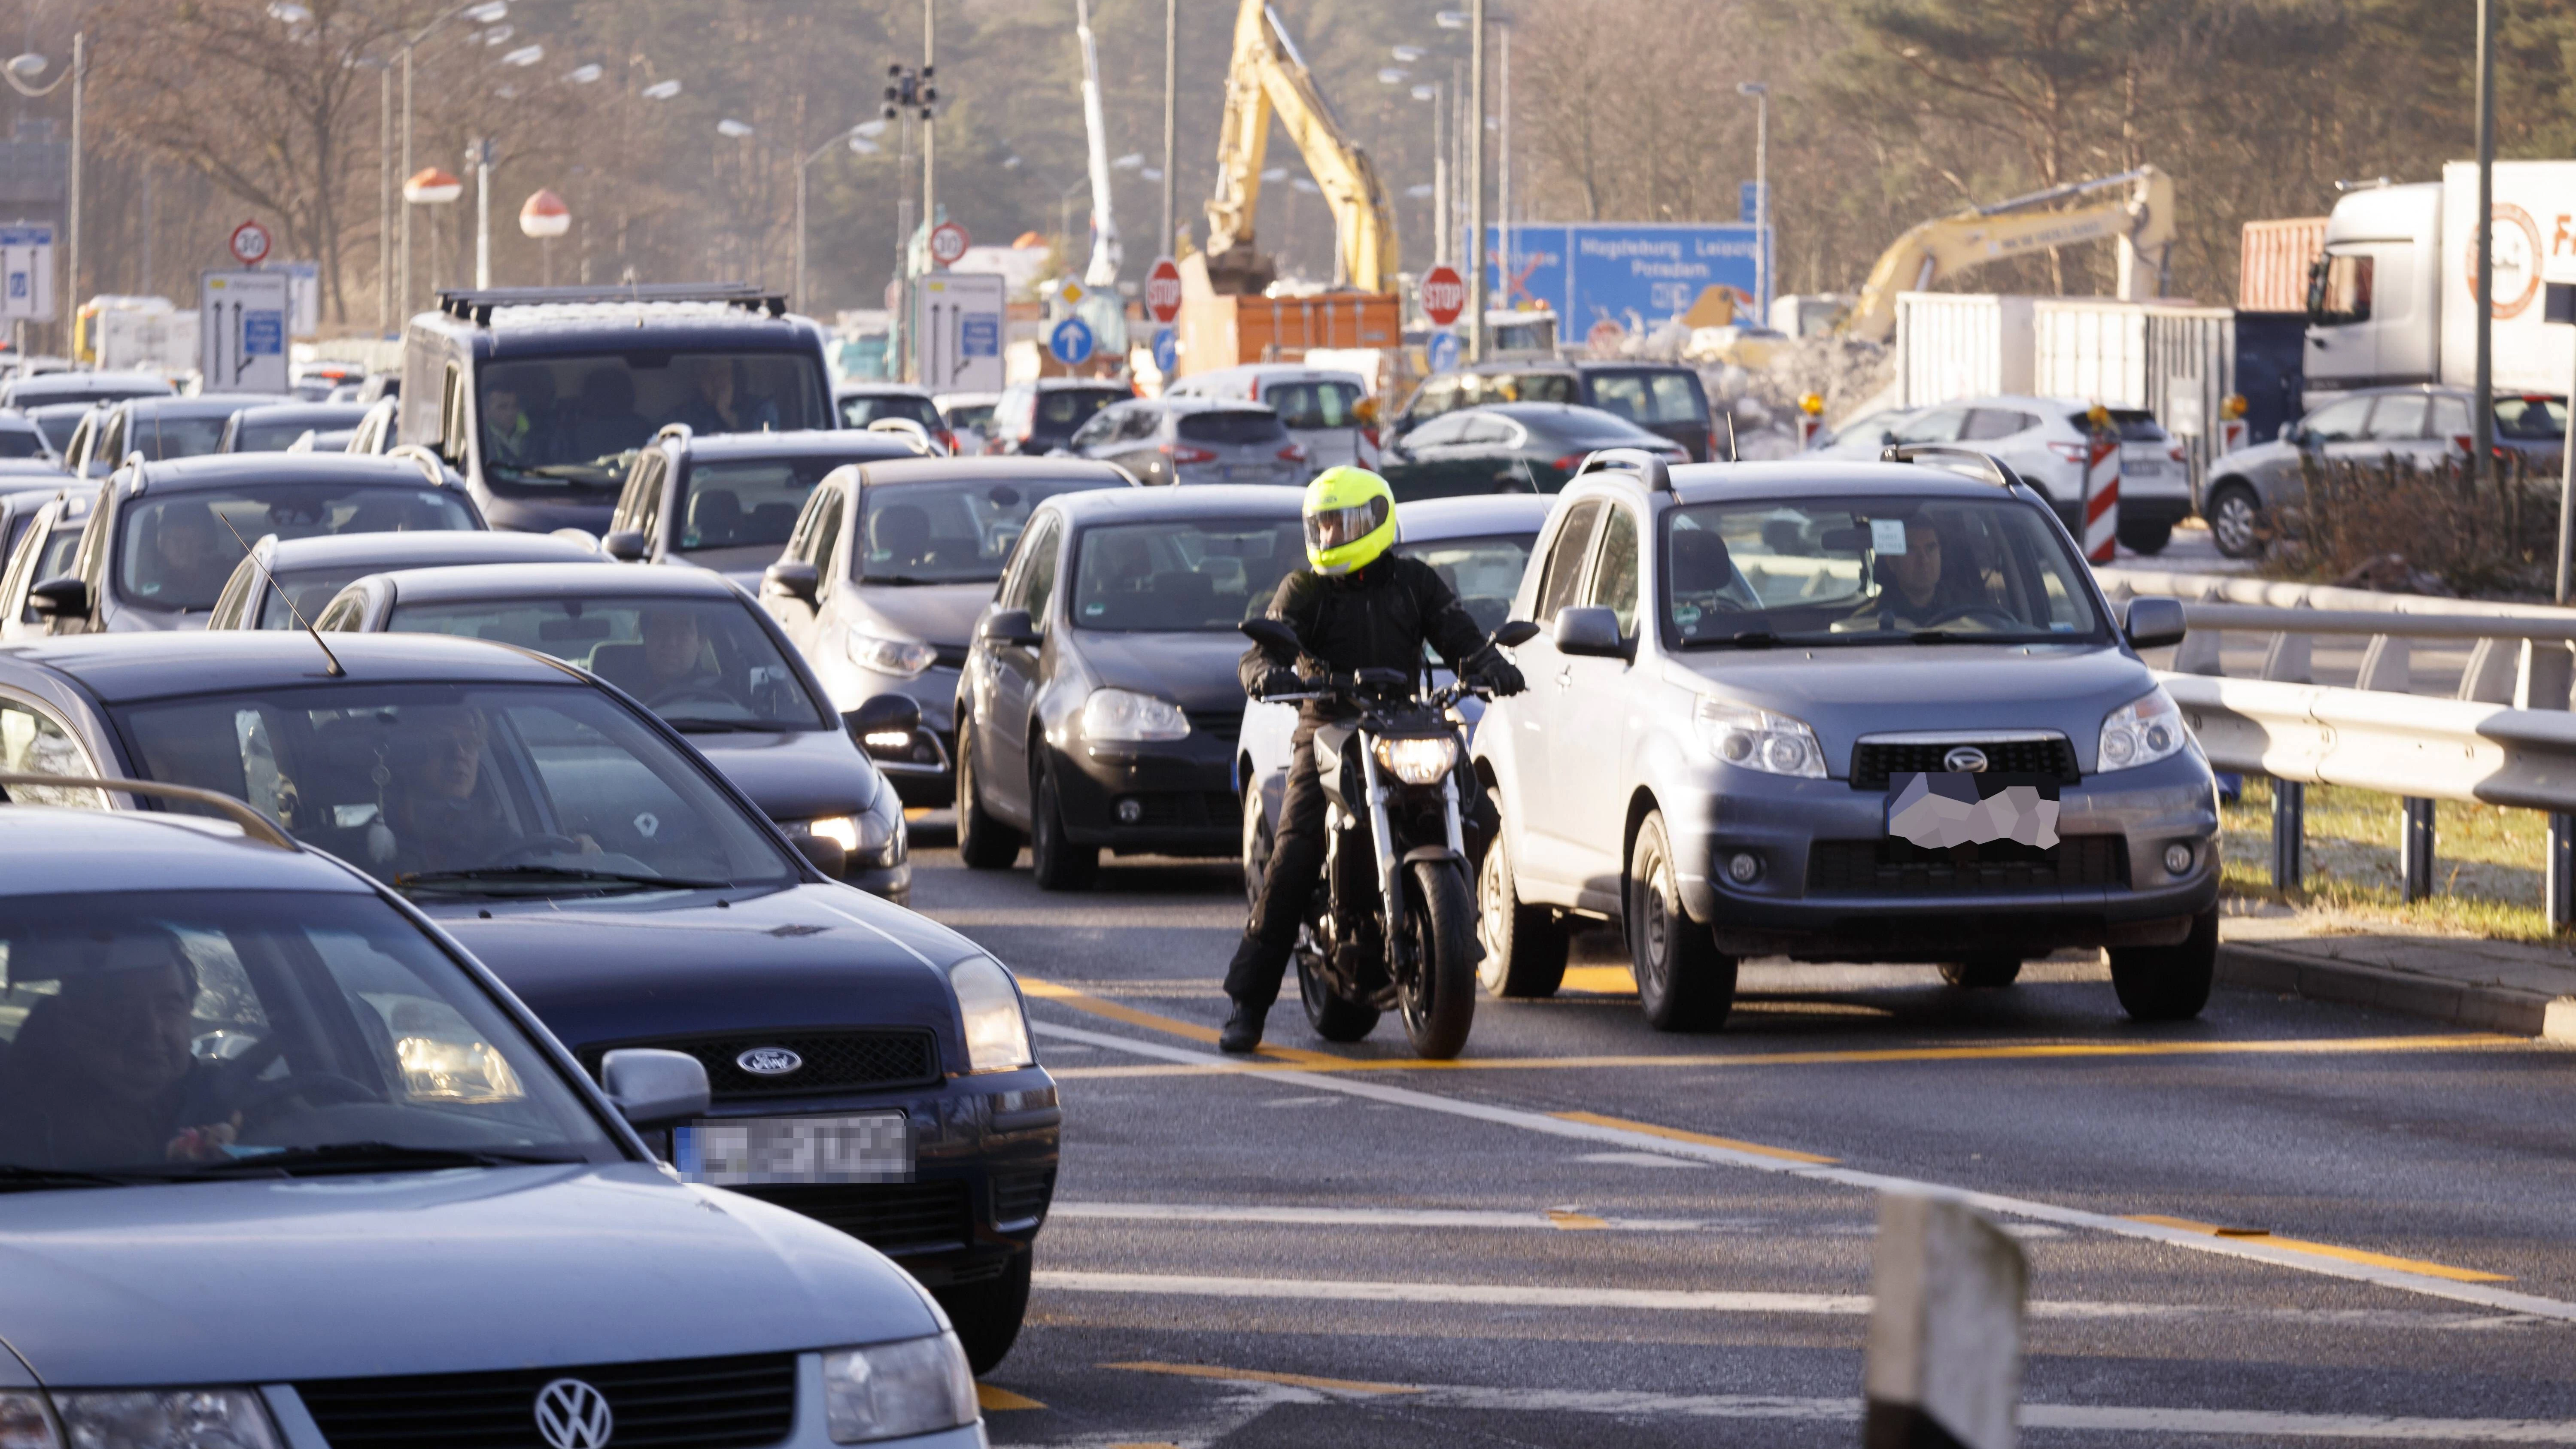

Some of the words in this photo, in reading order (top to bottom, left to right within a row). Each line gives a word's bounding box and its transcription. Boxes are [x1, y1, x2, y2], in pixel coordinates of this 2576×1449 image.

[237, 234, 261, 252] 30
[1580, 238, 1682, 260] Magdeburg
[1631, 259, 1710, 278] Potsdam
[1148, 279, 1180, 306] STOP
[1422, 283, 1462, 309] STOP
[752, 1051, 788, 1069] Ford
